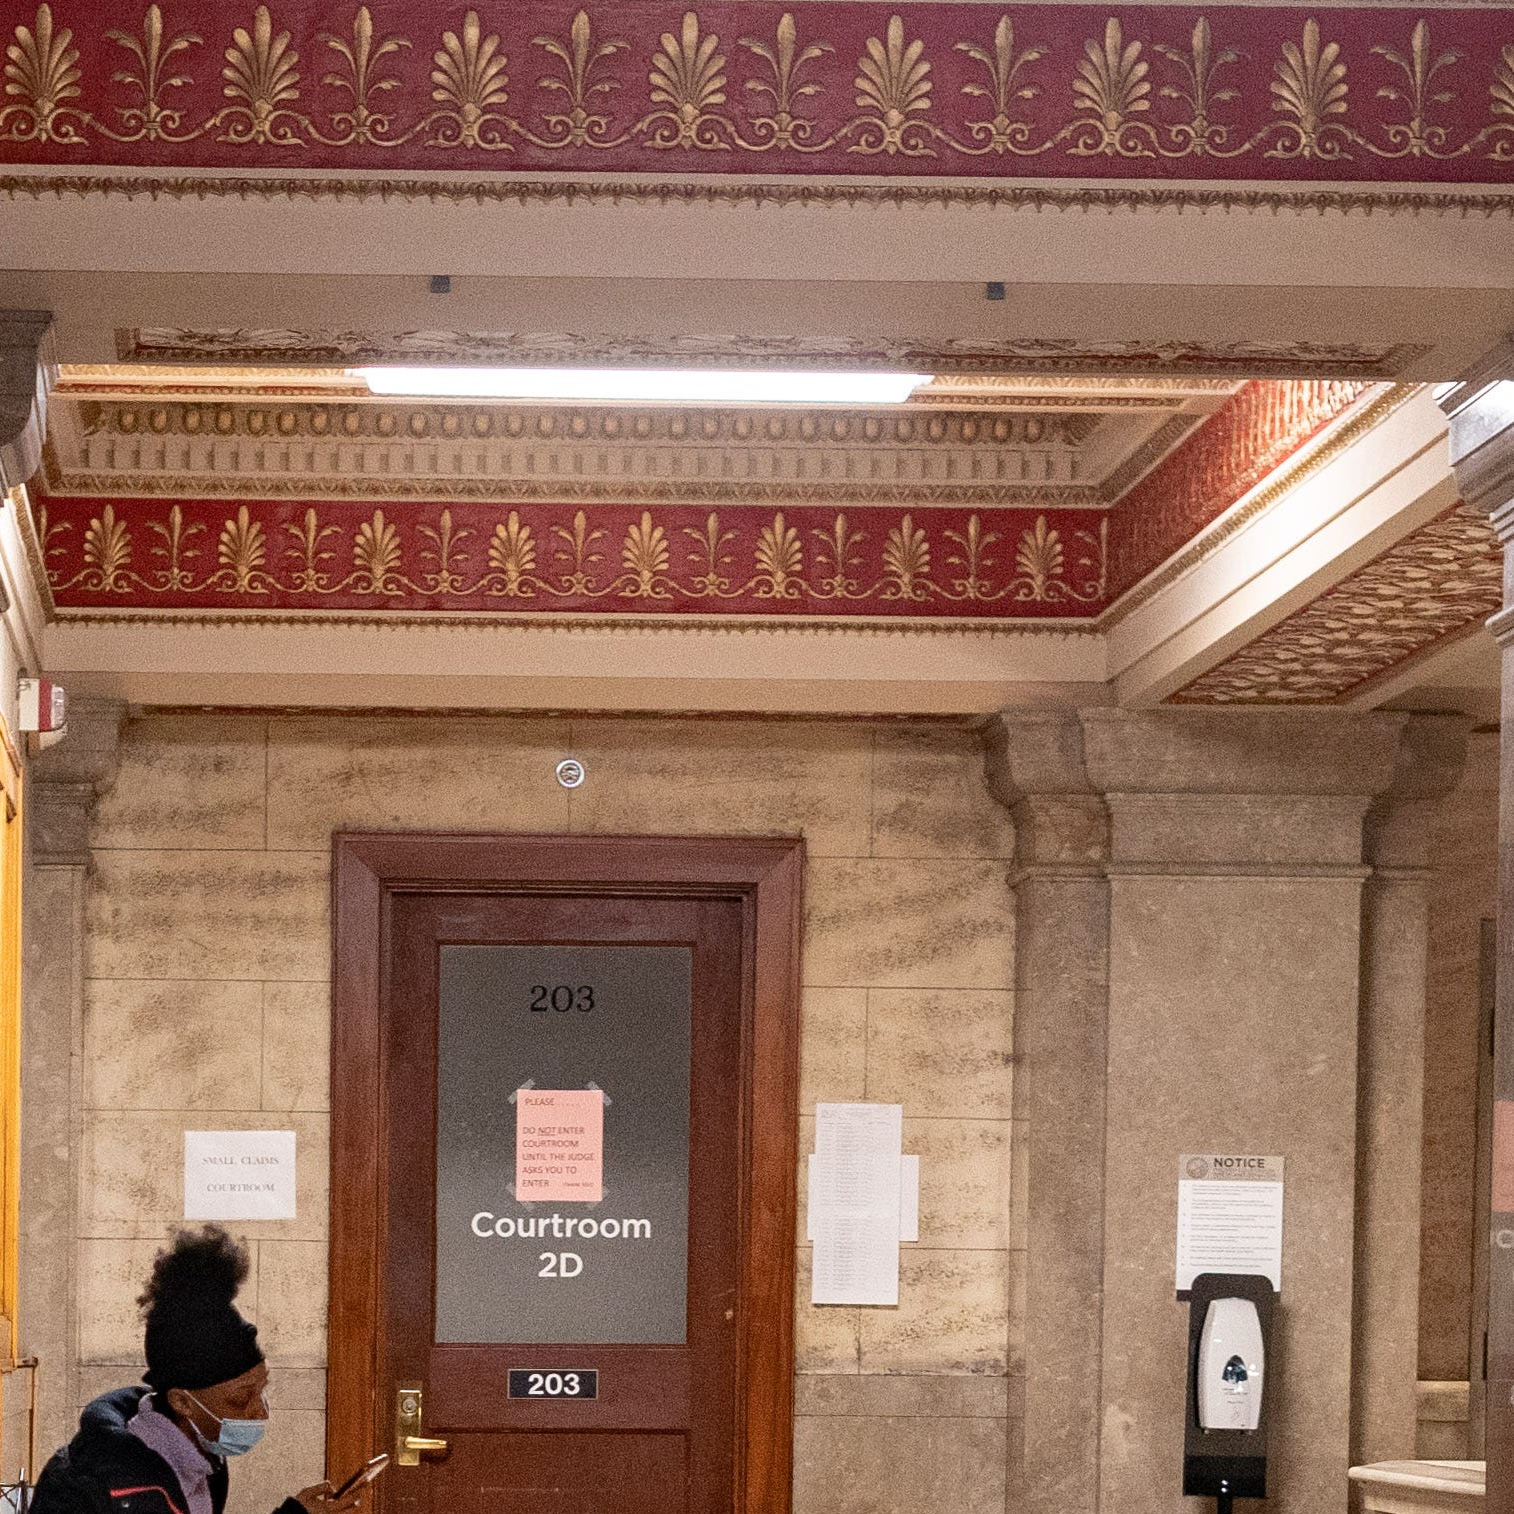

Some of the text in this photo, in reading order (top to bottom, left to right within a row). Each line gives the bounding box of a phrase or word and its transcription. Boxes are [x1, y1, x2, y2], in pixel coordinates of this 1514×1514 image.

[530, 985, 595, 1012] 203
[525, 1097, 554, 1106] PLEASE
[522, 1126, 585, 1136] DO NOT ENTER
[522, 1140, 579, 1148] COURTROOM
[202, 1156, 280, 1165] SMALL CLAIMS
[522, 1153, 594, 1161] UNTIL THE JUDGE
[1213, 1157, 1266, 1169] NOTICE
[522, 1166, 577, 1175] ASKS YOU TO
[206, 1183, 275, 1192] COURTROOM
[522, 1180, 550, 1188] ENTER
[471, 1211, 652, 1239] Courtroom
[538, 1252, 584, 1278] 2D
[527, 1373, 581, 1395] 203
